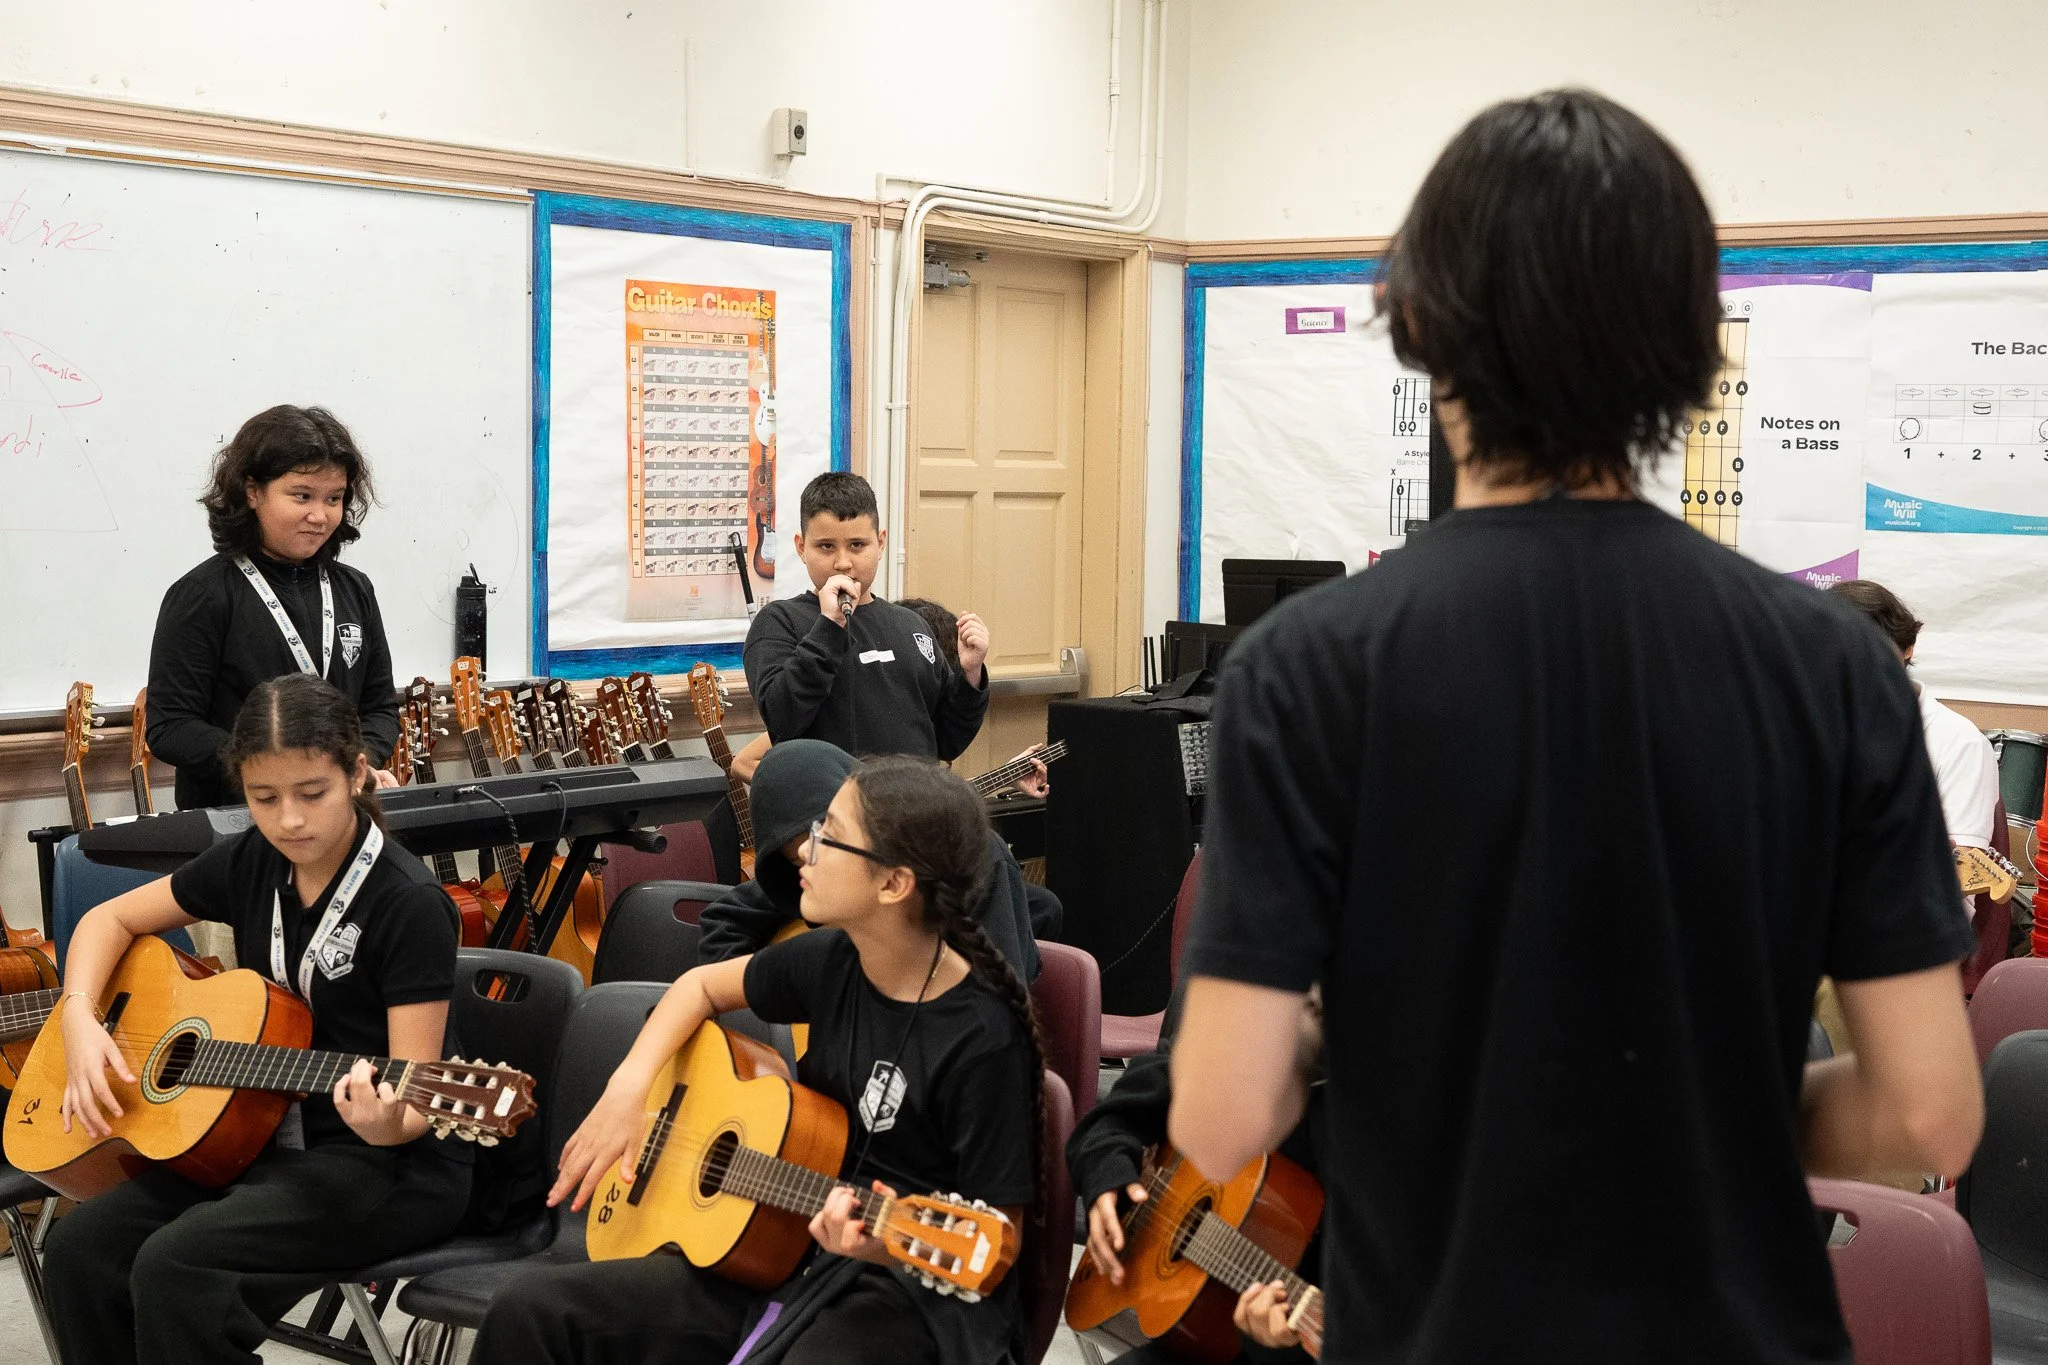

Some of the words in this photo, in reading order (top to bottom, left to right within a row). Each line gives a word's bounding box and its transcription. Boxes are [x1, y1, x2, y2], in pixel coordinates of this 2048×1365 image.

[627, 287, 696, 315] Guitar
[701, 292, 773, 320] Chords
[1971, 341, 2006, 355] The
[2011, 342, 2048, 355] Bac
[1760, 416, 1815, 430] Notes
[1818, 420, 1840, 430] on
[1781, 439, 1791, 449] a
[1796, 437, 1839, 450] Bass
[1904, 447, 1911, 459] 1
[1972, 449, 1981, 460] 2
[1884, 498, 1923, 509] Music
[1893, 508, 1918, 519] Will
[1806, 571, 1841, 582] Music
[18, 1098, 41, 1125] 31
[598, 1182, 621, 1224] 28
